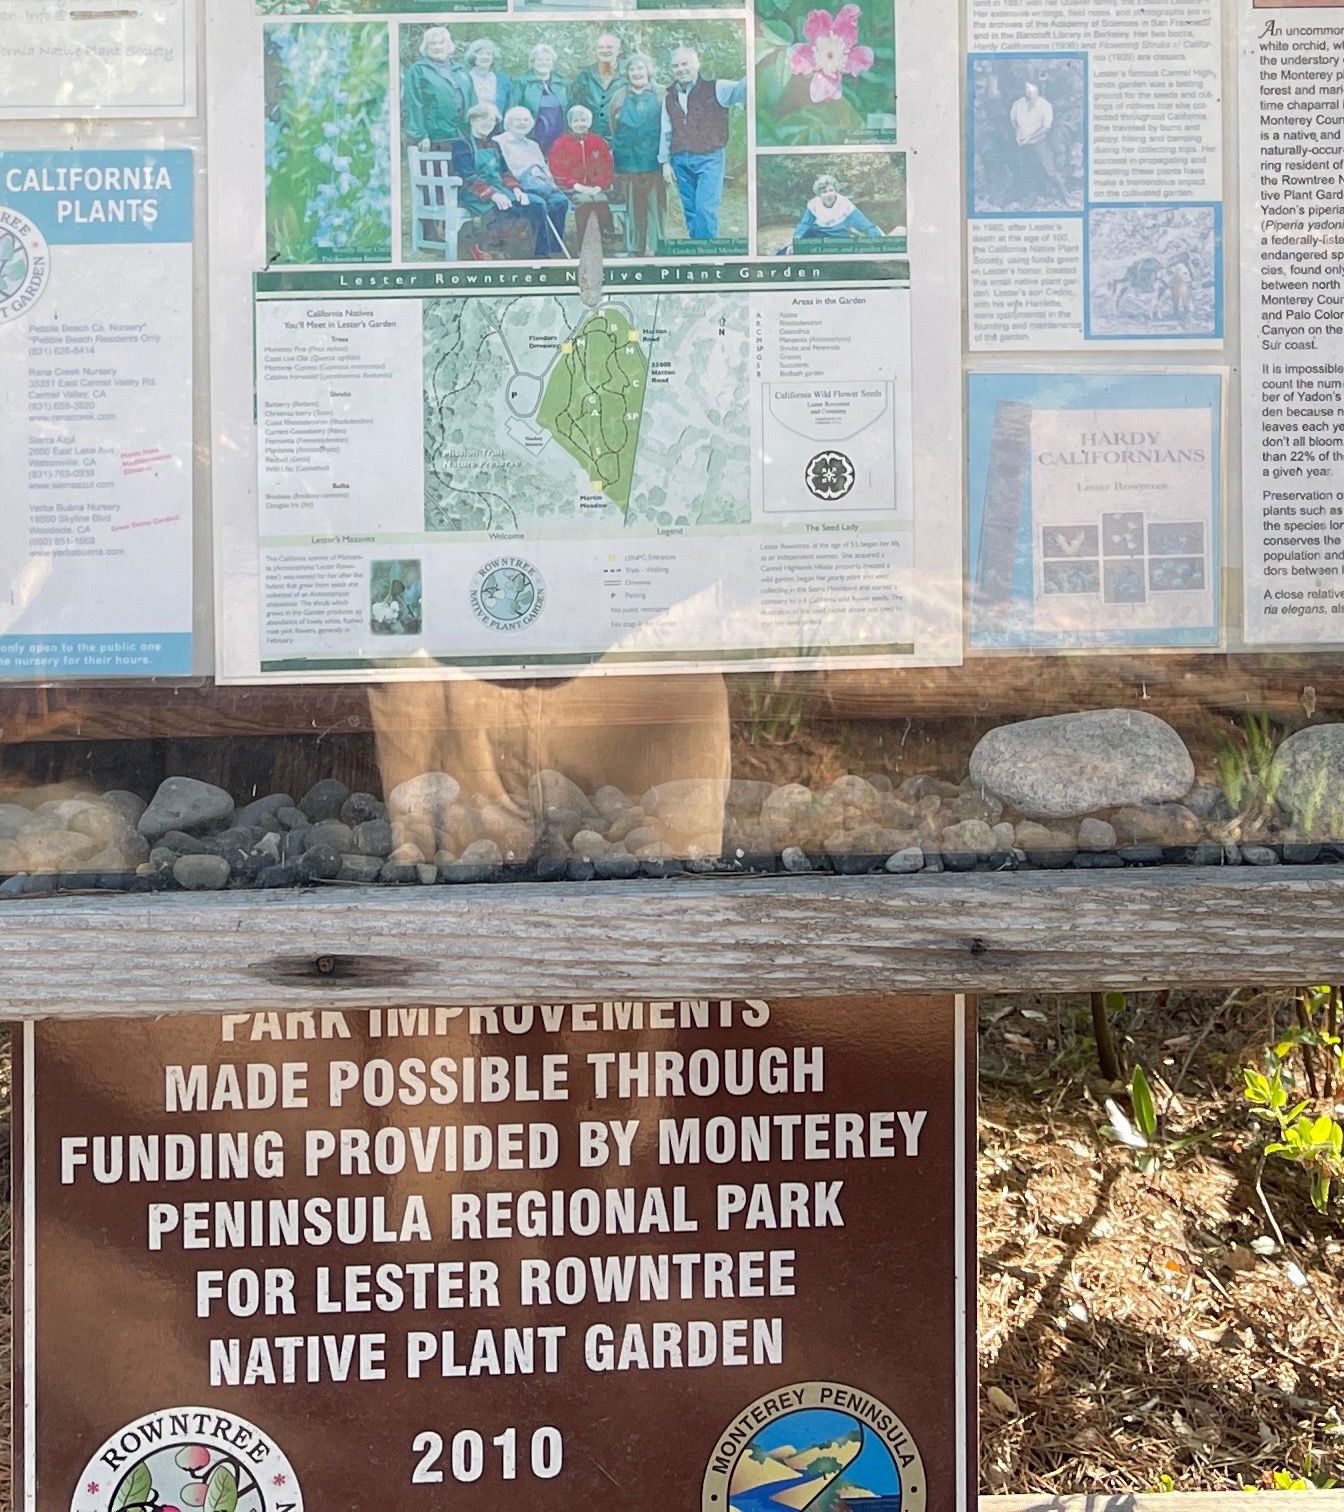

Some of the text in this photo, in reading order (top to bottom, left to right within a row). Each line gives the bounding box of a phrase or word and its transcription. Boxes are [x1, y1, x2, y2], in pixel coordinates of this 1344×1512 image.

[1258, 20, 1282, 38] An
[1259, 42, 1289, 51] white
[1292, 41, 1329, 51] orchid,
[1260, 56, 1277, 65] the
[1281, 55, 1339, 67] understory
[1260, 71, 1277, 80] the
[1281, 71, 1333, 82] Monterey
[1260, 86, 1291, 95] forest
[1295, 85, 1316, 95] and
[1260, 101, 1283, 110] time
[1287, 100, 1339, 112] chaparral
[1260, 116, 1312, 127] Monterey
[6, 167, 172, 192] CALIFORNIA
[58, 199, 159, 223] PLANTS
[12, 256, 44, 312] GARDEN
[340, 267, 820, 286] Lester Rowntree Nive Plant Garden
[307, 310, 343, 318] California
[775, 391, 812, 399] California
[1081, 432, 1161, 446] HARDY
[1262, 436, 1290, 447] don't
[1293, 436, 1306, 446] all
[1038, 449, 1205, 465] CALIFORNIANS
[657, 528, 683, 536] Legend
[842, 524, 859, 532] Lady
[479, 558, 535, 577] ROWNTREE
[470, 588, 544, 630] NATIVE PLANT GARDEN
[0, 643, 24, 654] only
[29, 644, 58, 654] open
[62, 643, 73, 652] to
[78, 642, 96, 651] the
[100, 642, 136, 653] public
[140, 643, 161, 651] one
[14, 658, 59, 667] nursery
[63, 656, 80, 665] for
[84, 656, 111, 665] their
[115, 656, 153, 664] hours.
[221, 999, 771, 1042] PARK IMPROVEMENTS
[165, 1046, 825, 1113] MADE POSSIBLE THROUGH
[60, 1110, 929, 1186] FUNDING PROVIDED BY MONTEREY
[148, 1180, 845, 1251] PENINSULA REGIONAL PARK
[195, 1249, 796, 1318] FOR LESTER ROWNTREE
[208, 1318, 783, 1387] NATIVE PLANT GARDEN
[712, 1388, 916, 1476] MONTEREY PENINSULA
[99, 1413, 270, 1473] ROWNTREE
[411, 1426, 564, 1485] 2010
